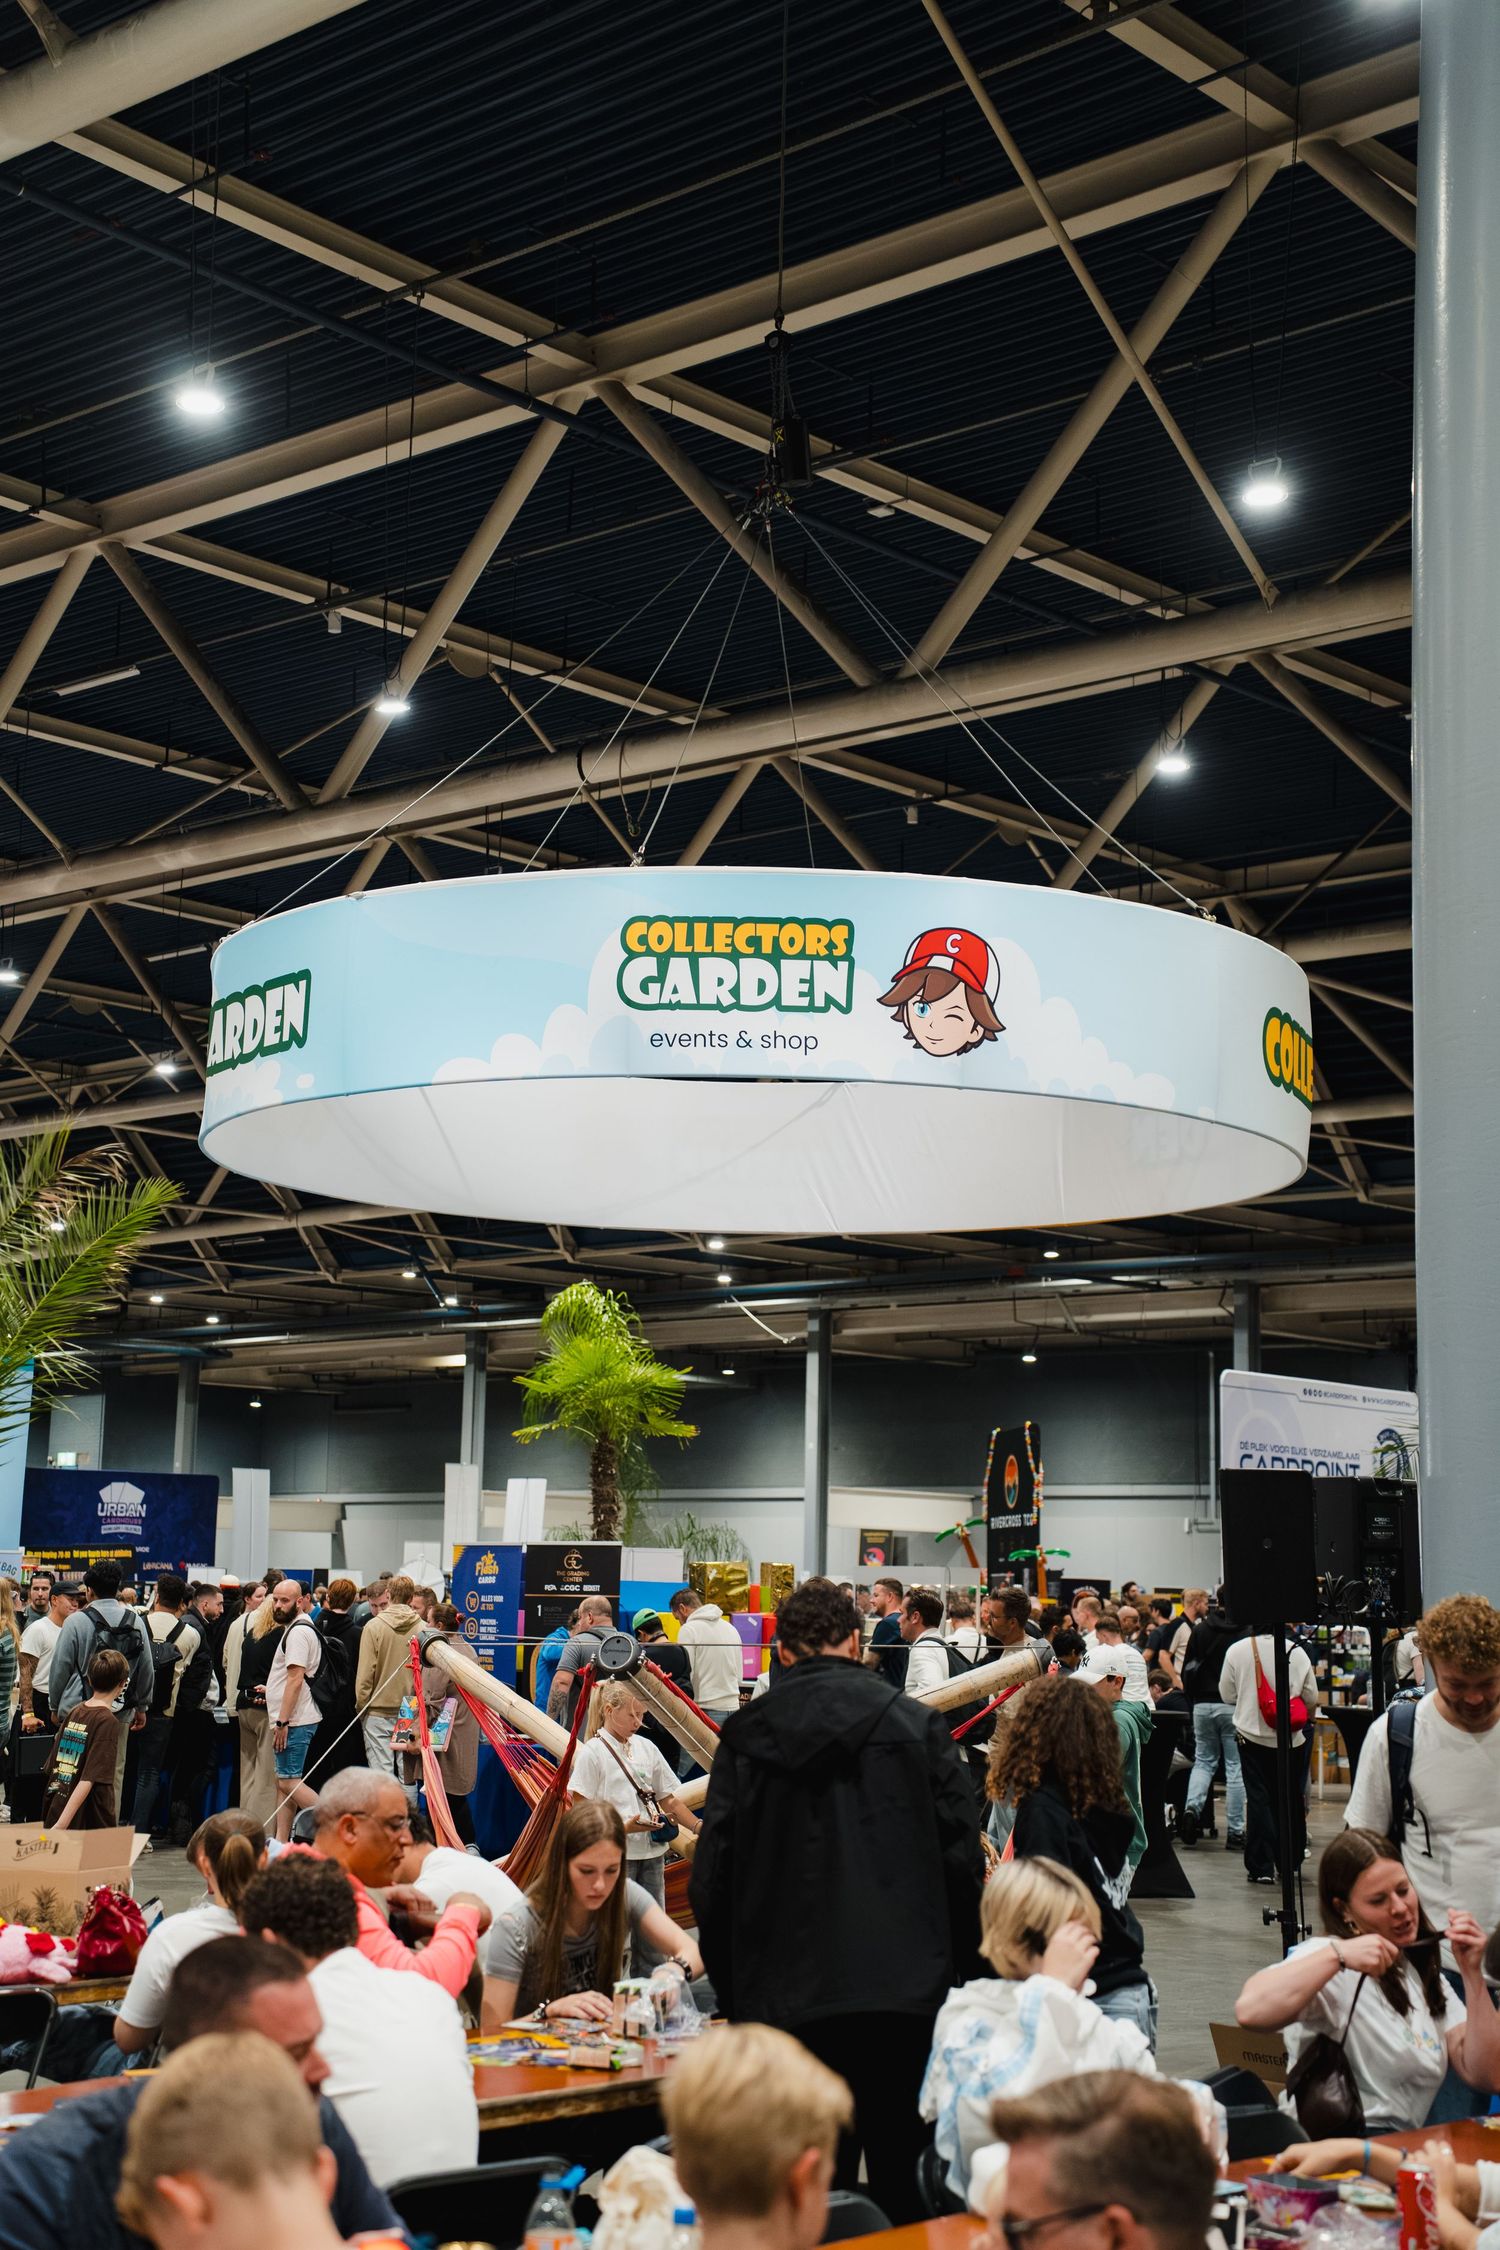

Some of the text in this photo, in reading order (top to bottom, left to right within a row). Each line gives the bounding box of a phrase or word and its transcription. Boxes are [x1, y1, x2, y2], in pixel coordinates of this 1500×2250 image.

[625, 921, 849, 958] COLLECTORS
[945, 933, 963, 954] C
[622, 956, 850, 1008] GARDEN
[649, 1030, 820, 1056] events & shop
[1269, 1443, 1290, 1455] VOOR
[97, 1502, 147, 1518] URBAN
[990, 1514, 1022, 1529] RIVERCROSS
[1, 1562, 18, 1576] BAG
[536, 1604, 542, 1617] 1
